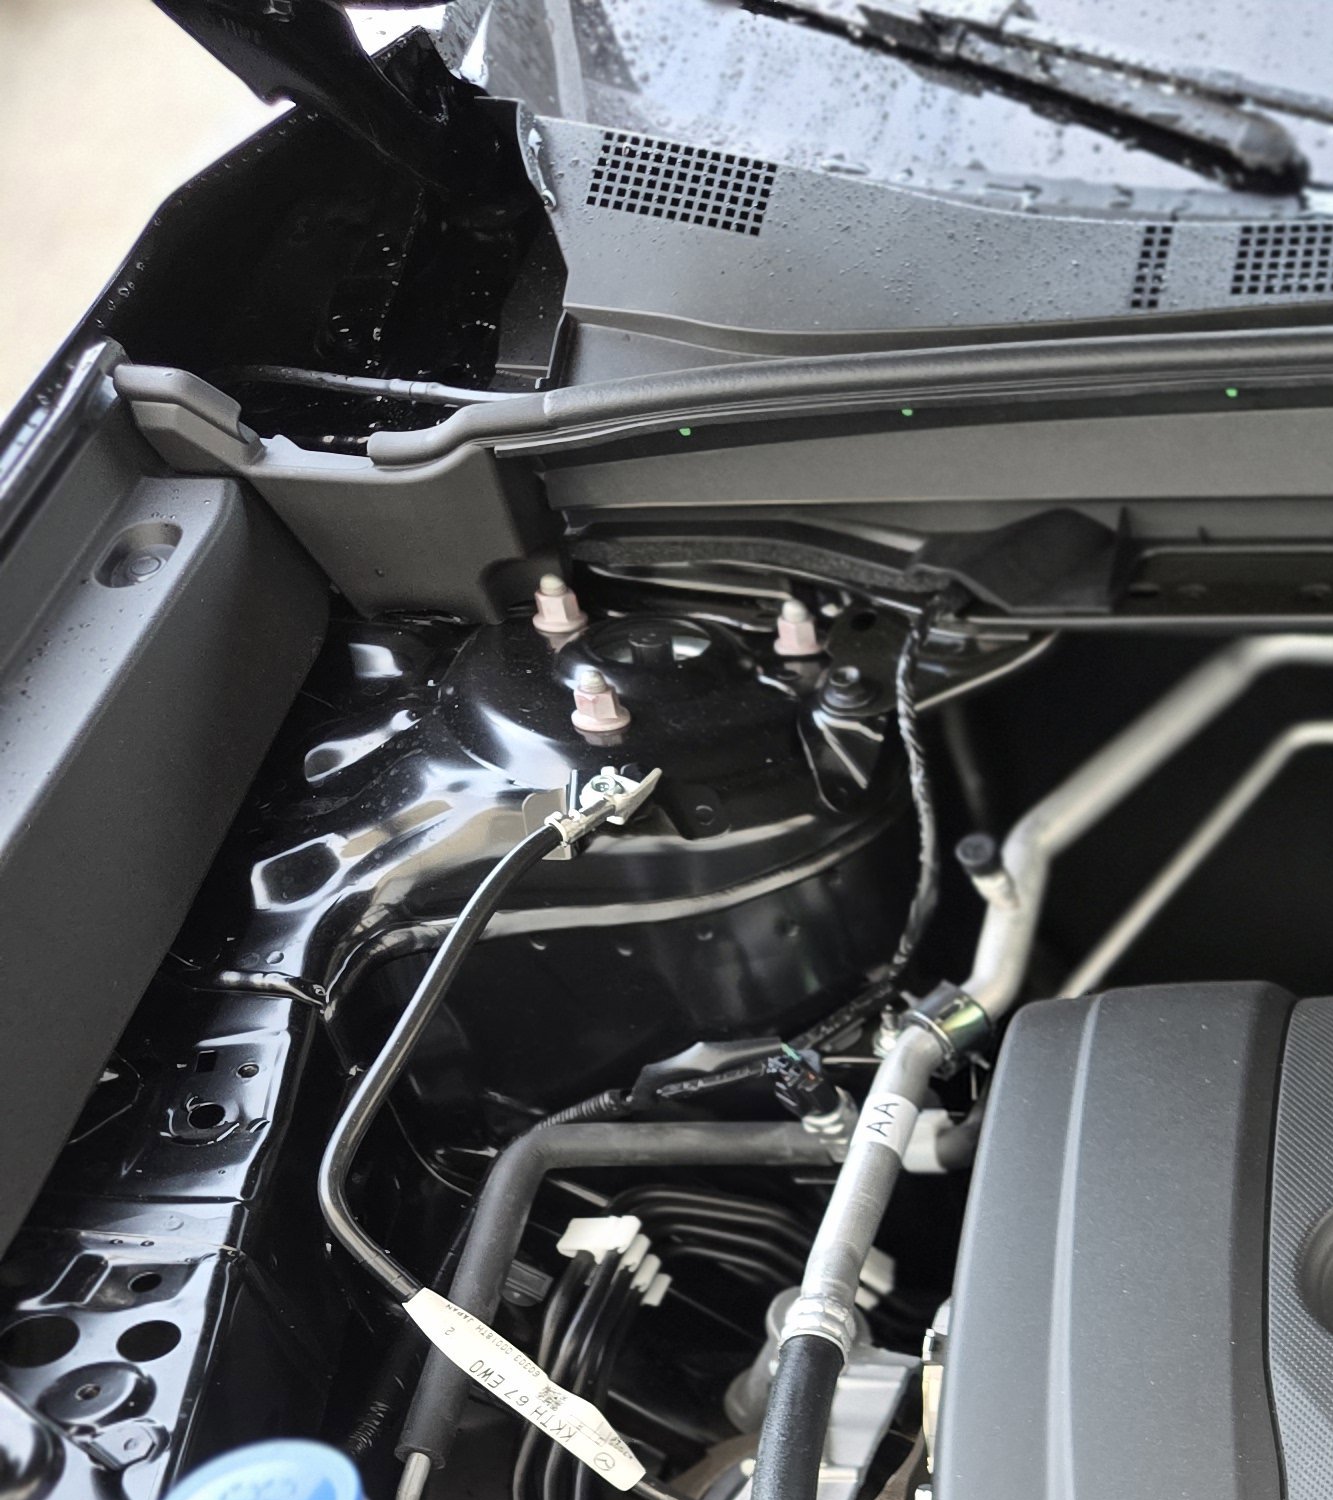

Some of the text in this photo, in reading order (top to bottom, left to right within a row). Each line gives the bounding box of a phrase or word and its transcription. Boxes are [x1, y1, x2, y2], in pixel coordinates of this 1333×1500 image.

[867, 1102, 900, 1137] AA
[446, 1302, 474, 1325] JAPAN
[504, 1385, 530, 1408] 67
[529, 1402, 577, 1444] KKTH
